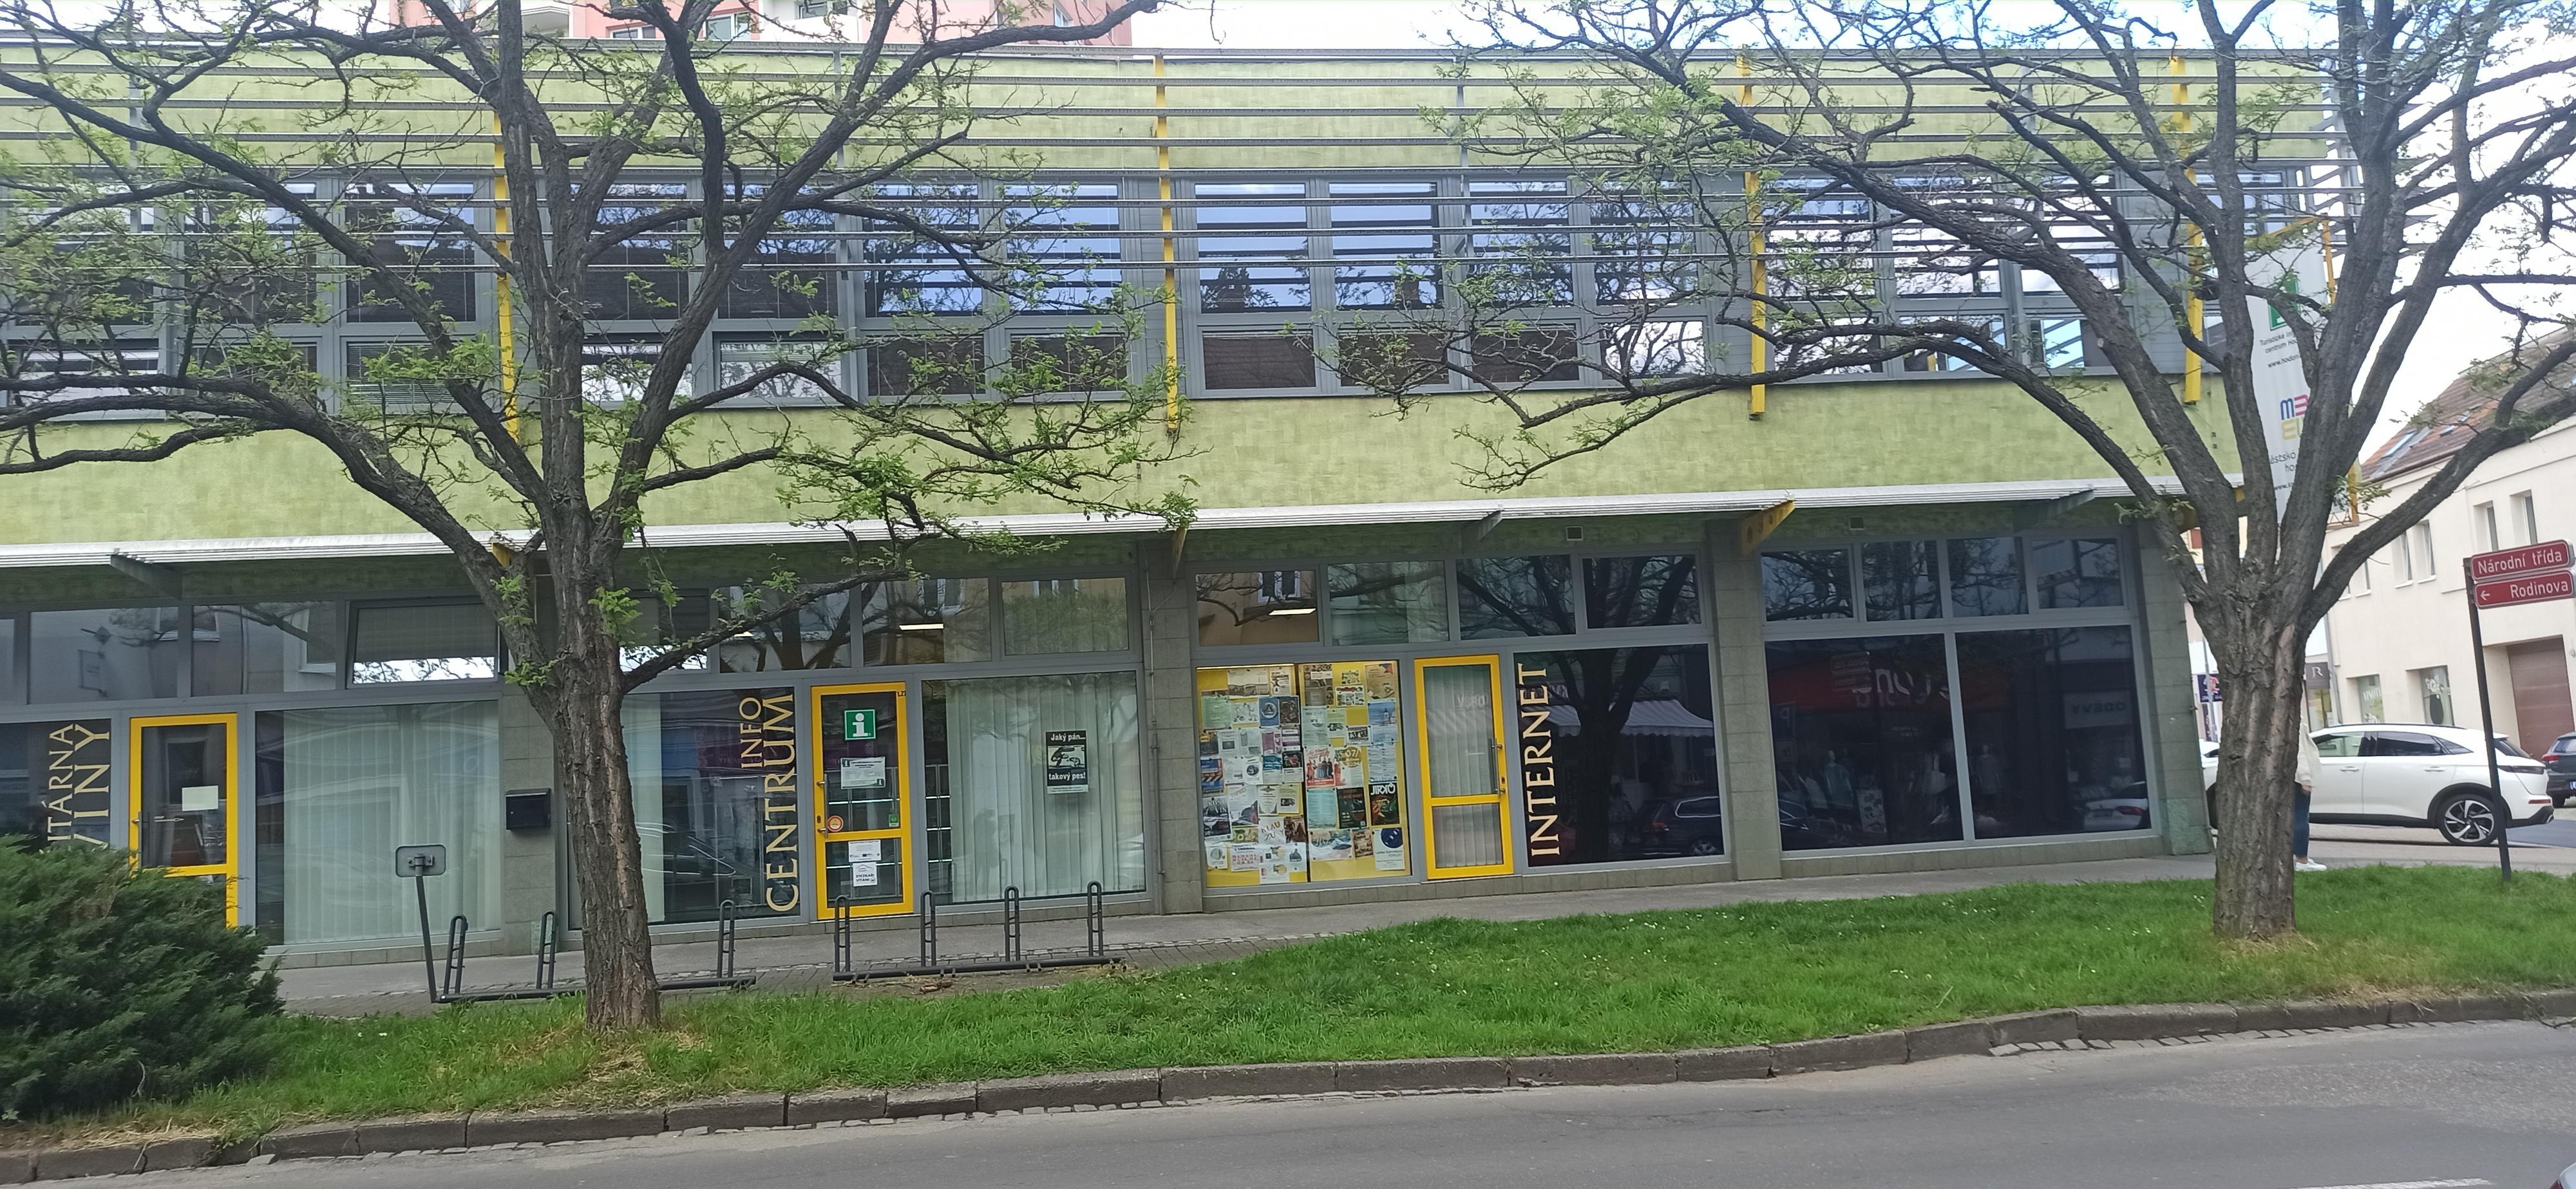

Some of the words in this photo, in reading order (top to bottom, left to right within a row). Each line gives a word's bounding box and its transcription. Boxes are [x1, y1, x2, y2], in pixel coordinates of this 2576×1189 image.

[2265, 342, 2287, 353] centrum
[2477, 553, 2526, 574] Národní
[2532, 548, 2562, 566] třída
[2510, 581, 2569, 599] Rodinova
[739, 697, 763, 769] INFO
[1050, 733, 1066, 742] Jaký
[1517, 662, 1561, 857] INTERNET
[1048, 772, 1070, 781] takový
[1072, 771, 1086, 780] pes!
[762, 694, 799, 912] CENTRUM
